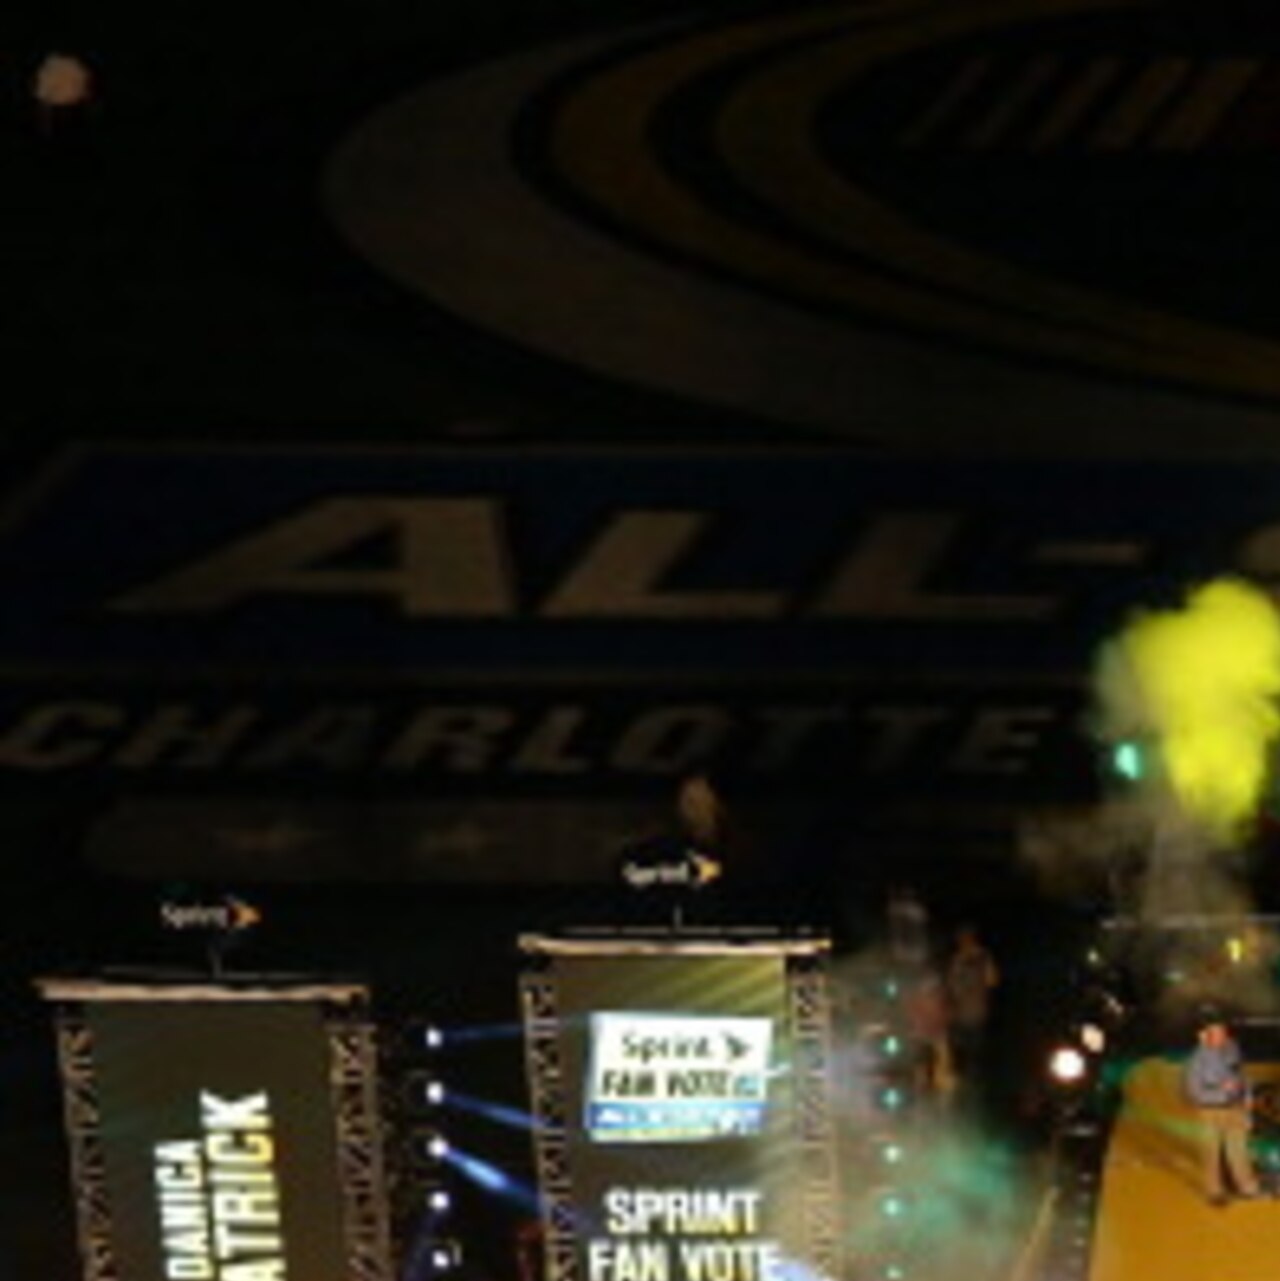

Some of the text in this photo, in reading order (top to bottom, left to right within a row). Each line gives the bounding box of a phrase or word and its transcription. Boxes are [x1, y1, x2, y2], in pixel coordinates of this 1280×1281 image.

[0, 700, 1070, 776] CHARLOTTE
[155, 1139, 214, 1281] DANICA
[606, 1190, 761, 1235] SPRINT
